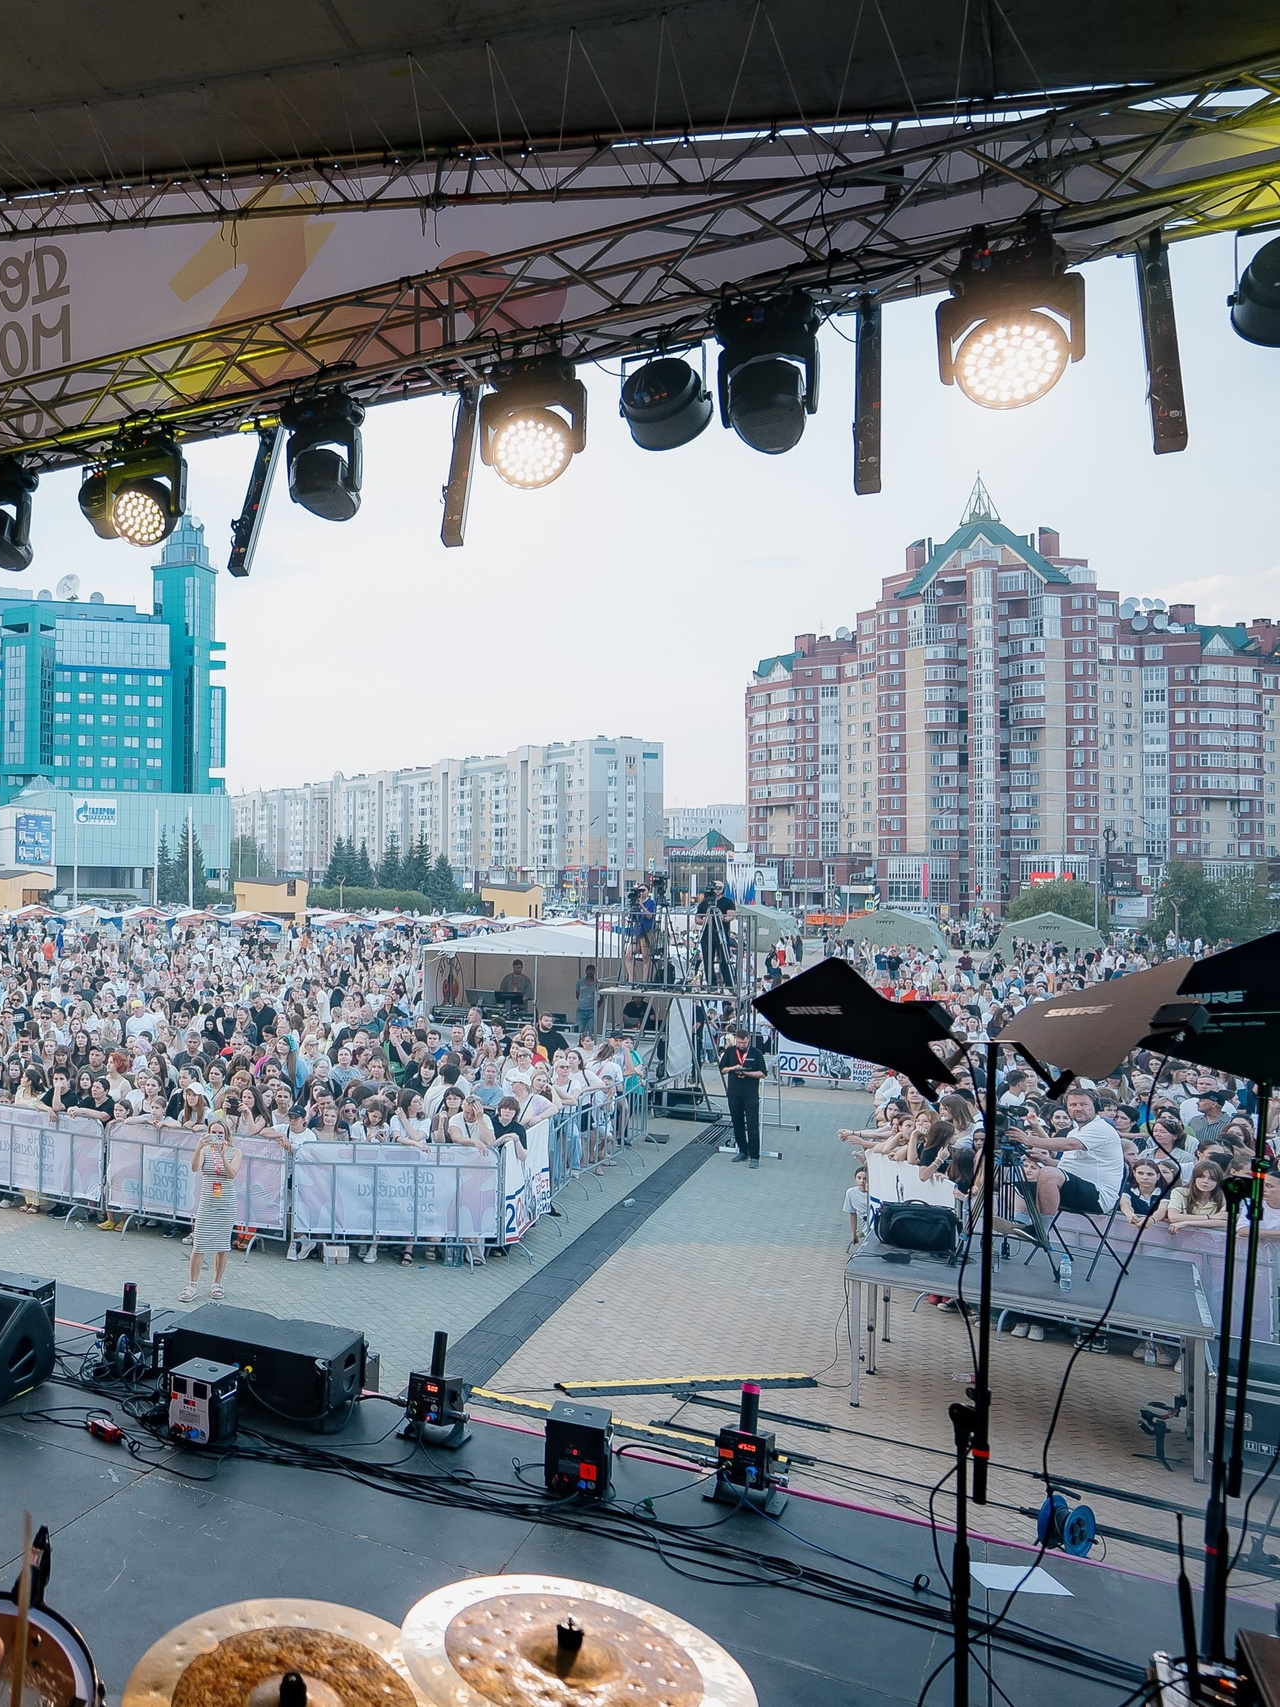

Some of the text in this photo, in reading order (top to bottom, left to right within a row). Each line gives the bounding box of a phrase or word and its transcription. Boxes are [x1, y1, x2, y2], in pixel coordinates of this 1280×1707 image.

[1179, 990, 1243, 1005] URE
[785, 1005, 843, 1016] SHURE
[1043, 1003, 1112, 1019] SHURE
[780, 1055, 818, 1073] 2026
